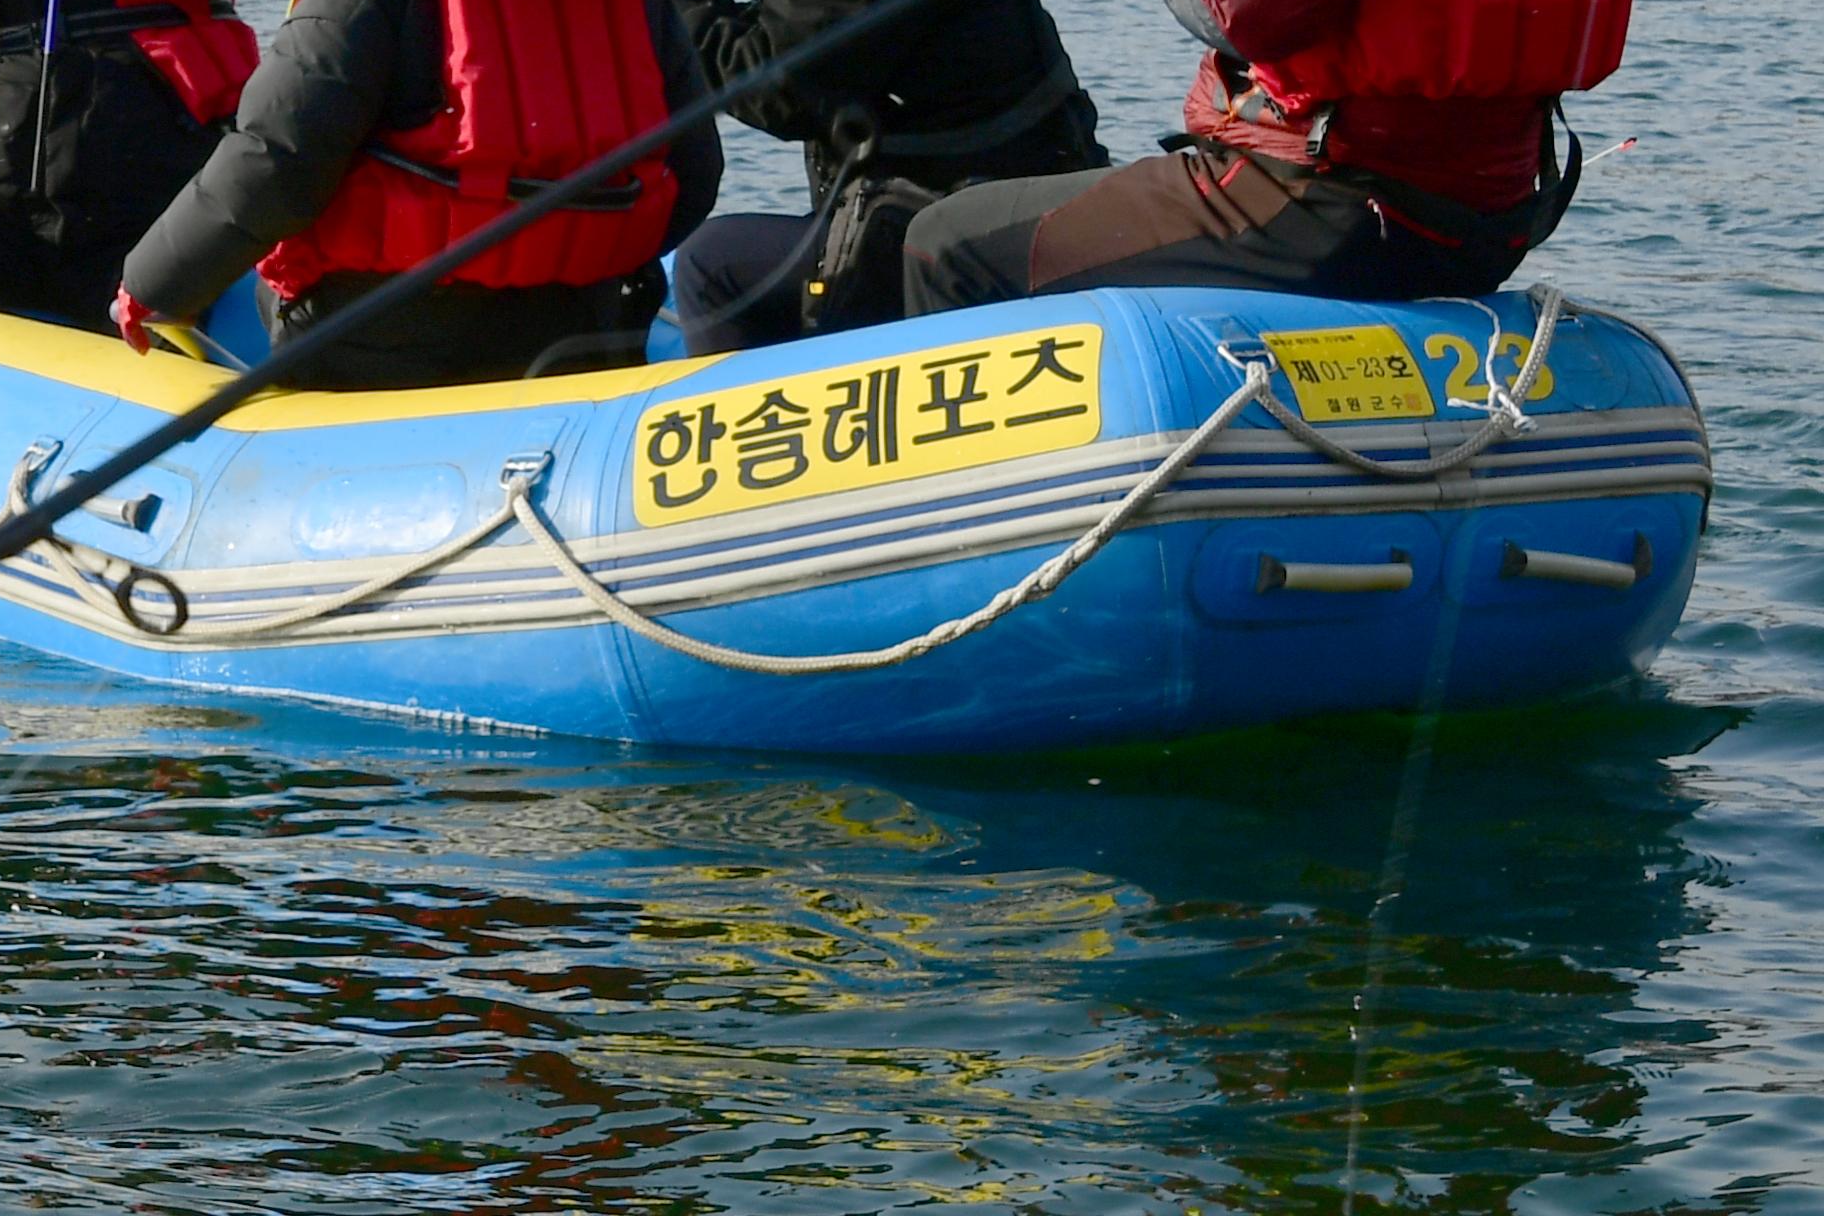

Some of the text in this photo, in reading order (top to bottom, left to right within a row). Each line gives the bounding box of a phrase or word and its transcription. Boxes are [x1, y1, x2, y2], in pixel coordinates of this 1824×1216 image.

[1290, 355, 1414, 384] 제01-23호
[1424, 332, 1556, 401] 23
[646, 337, 1088, 509] 한솔레포츠
